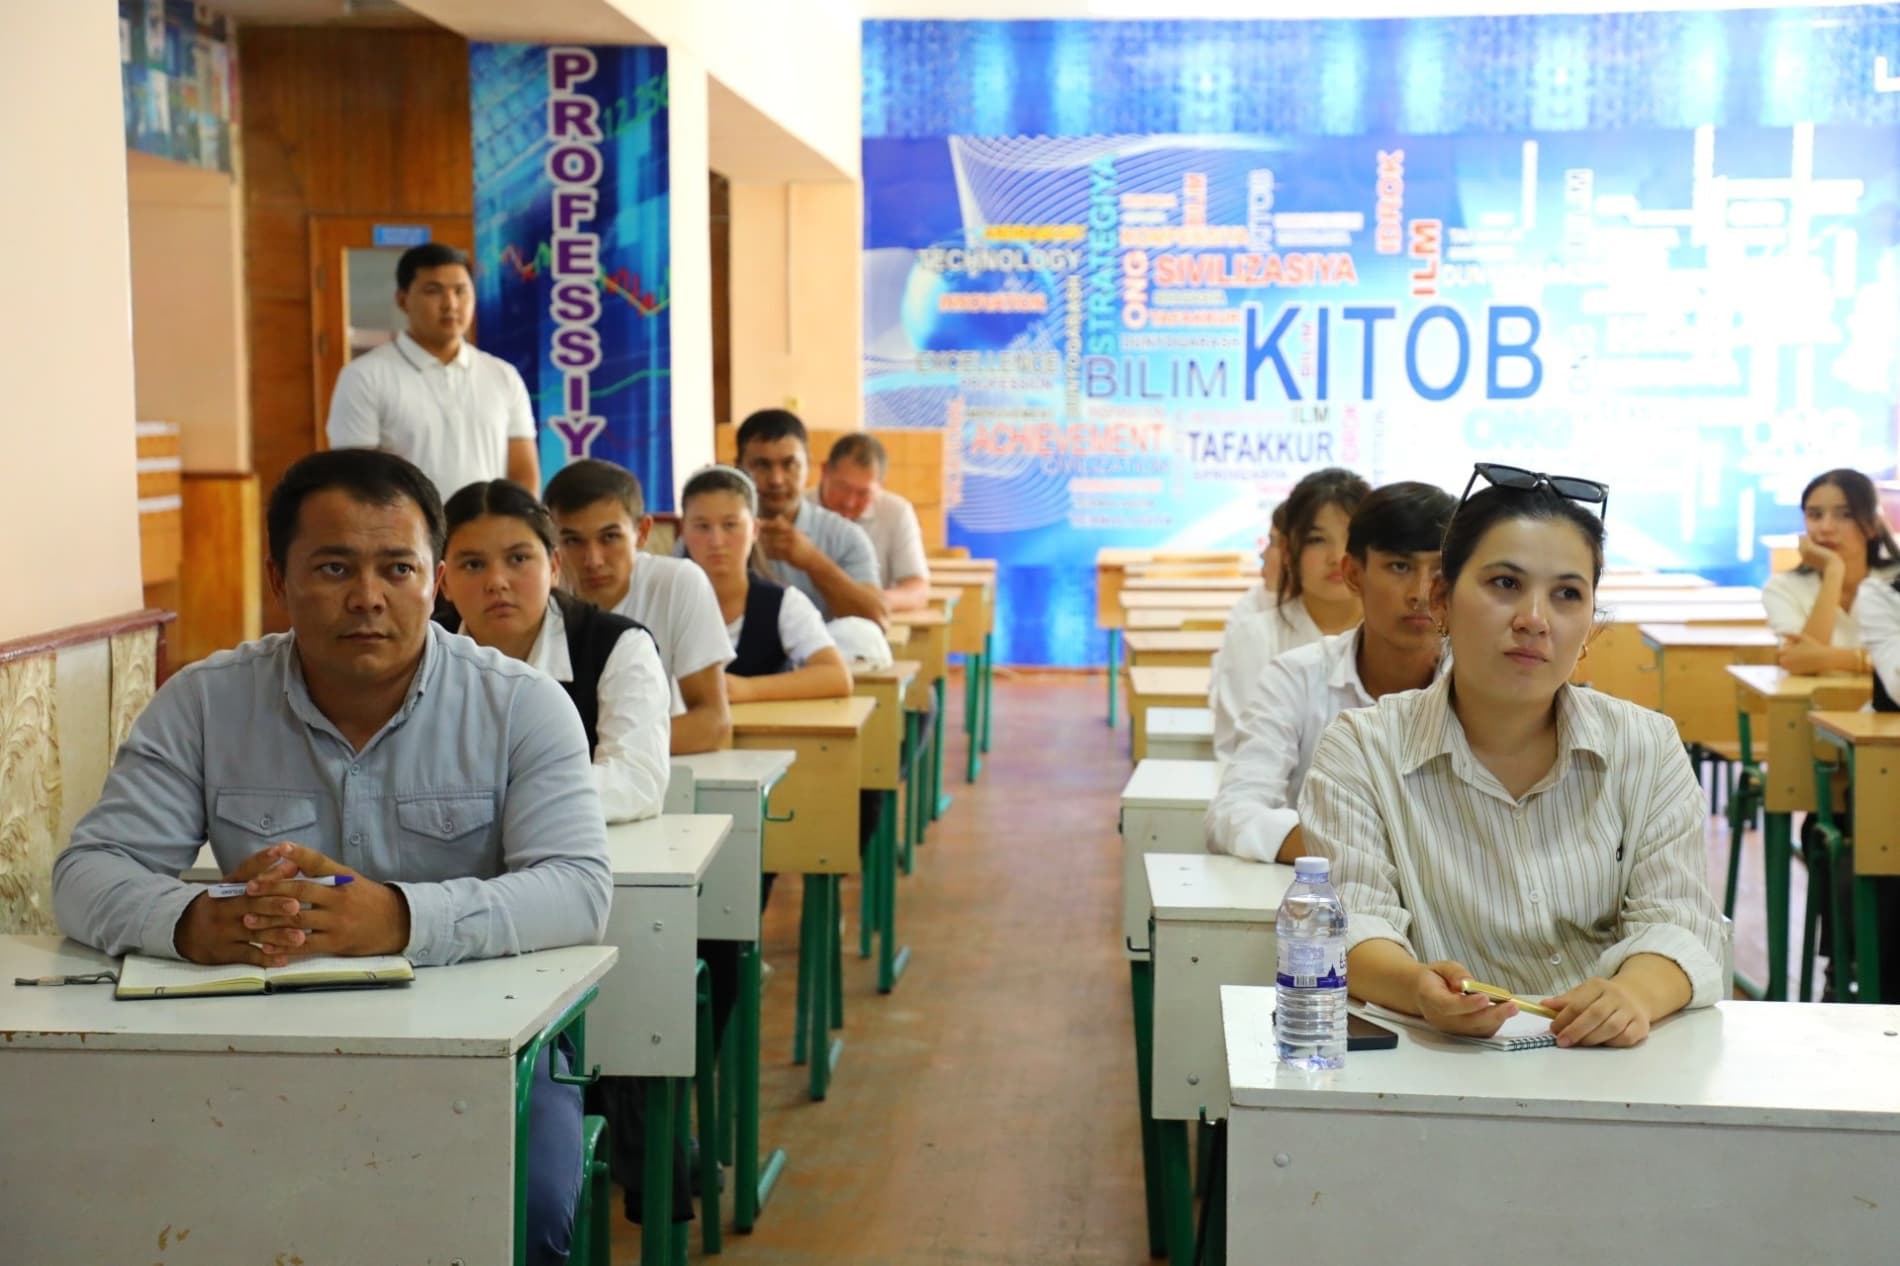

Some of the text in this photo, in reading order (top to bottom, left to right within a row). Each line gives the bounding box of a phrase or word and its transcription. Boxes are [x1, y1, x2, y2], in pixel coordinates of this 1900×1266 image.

[918, 247, 1081, 273] TECHNOLOGY
[1087, 152, 1118, 352] STRATEGIYA
[1154, 252, 1357, 286] SIVILIZASIYA
[1412, 220, 1440, 296] ILM
[1122, 250, 1149, 328] ONG
[1244, 303, 1545, 402] KITOB
[1086, 356, 1229, 399] BILIM
[1290, 406, 1330, 425] ILM
[970, 423, 1165, 456] ACHIEVEMENT
[1188, 430, 1335, 464] TAFAKKUR
